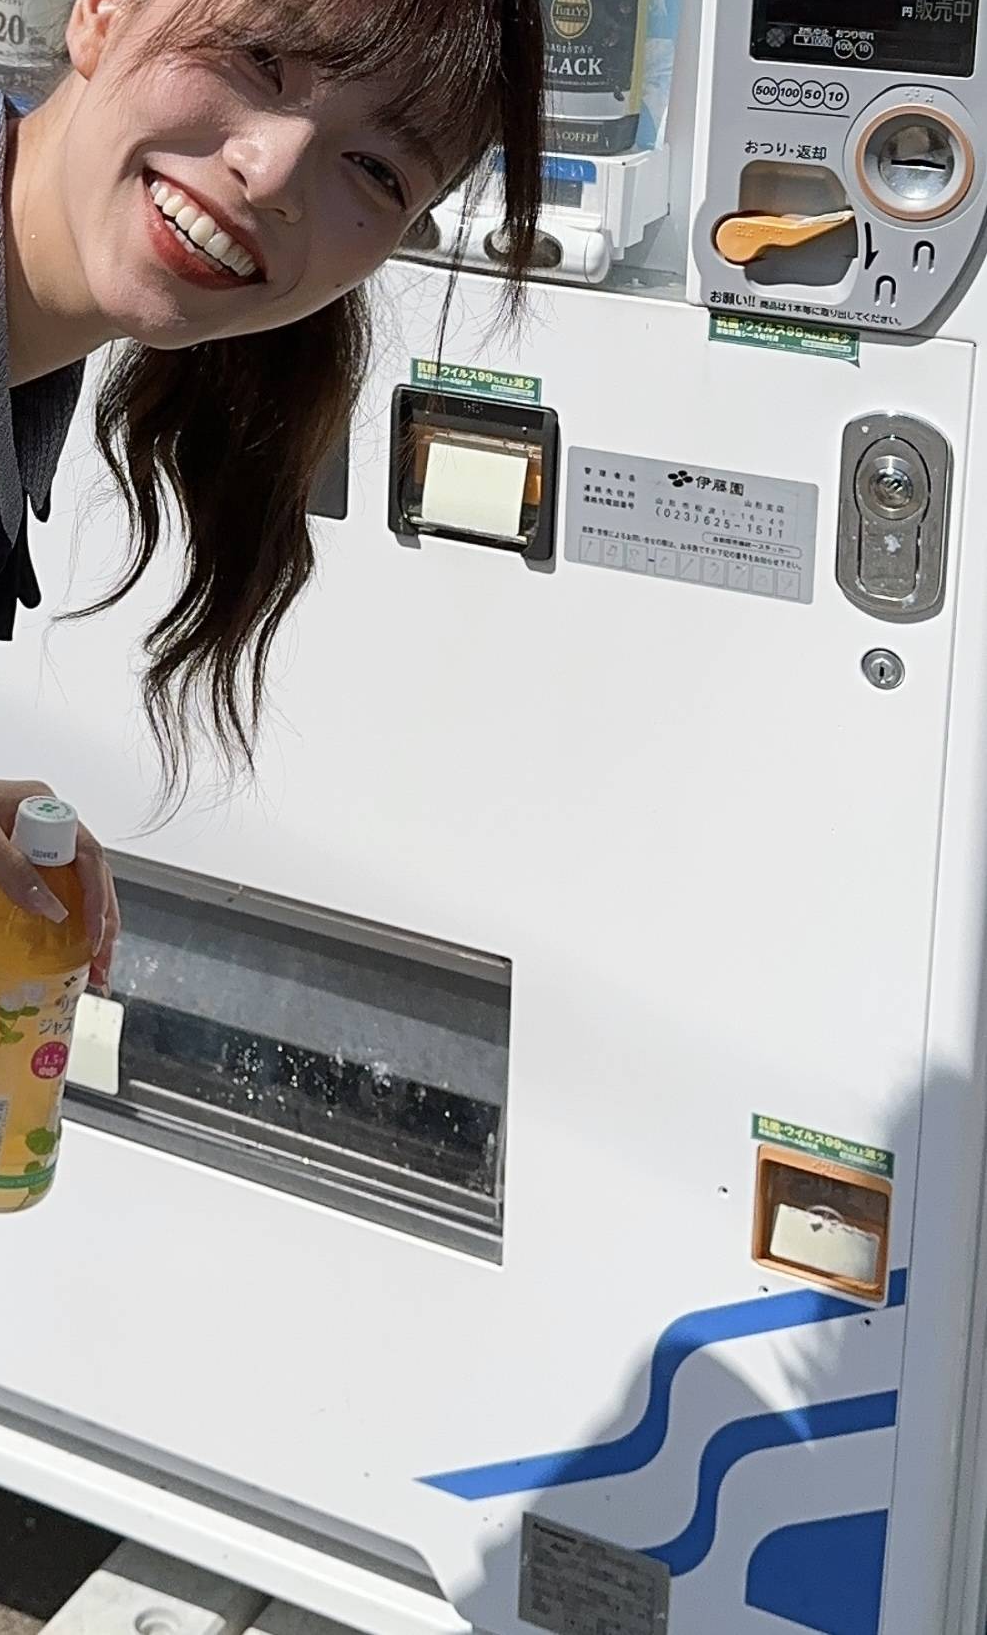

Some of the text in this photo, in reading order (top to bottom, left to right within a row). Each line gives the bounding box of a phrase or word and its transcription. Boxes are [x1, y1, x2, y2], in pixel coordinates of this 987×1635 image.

[901, 6, 913, 18] 円
[835, 29, 875, 40] おつり切れ
[836, 42, 869, 52] 100 10
[755, 85, 844, 102] 500 100 50 10
[563, 131, 599, 143] COFFEE
[744, 139, 827, 161] おつり・返却
[709, 290, 903, 327] お願い!! 商品は1本毎に取り出してください。
[695, 475, 745, 497] 伊藤園
[744, 499, 785, 514] 山形支店
[654, 506, 784, 539] (023)625-1511
